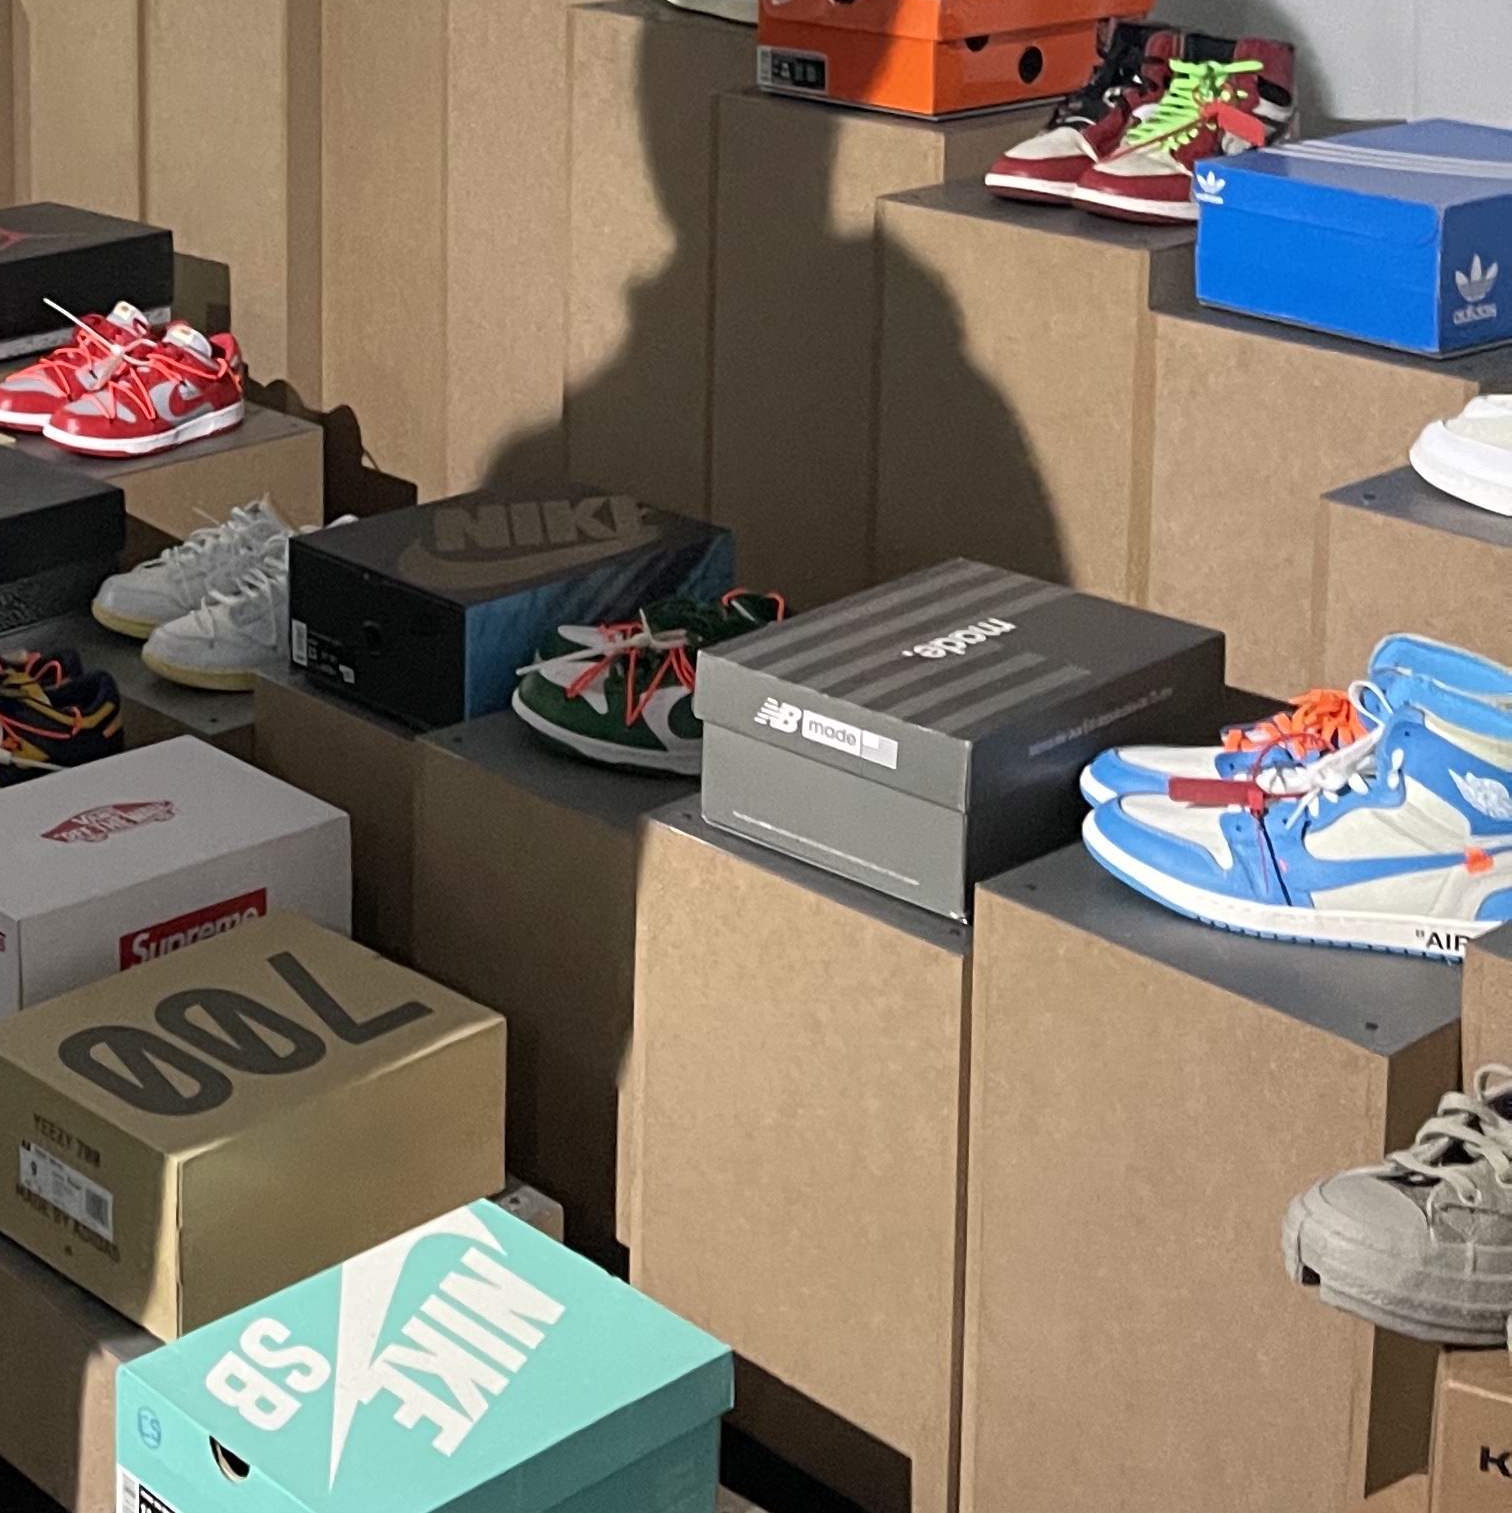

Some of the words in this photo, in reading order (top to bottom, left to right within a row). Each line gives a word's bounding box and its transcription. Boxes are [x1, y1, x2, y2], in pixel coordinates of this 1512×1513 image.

[808, 719, 857, 747] made
[58, 950, 435, 1116] 700
[204, 1316, 332, 1432] SB
[364, 1246, 567, 1457] NIKE
